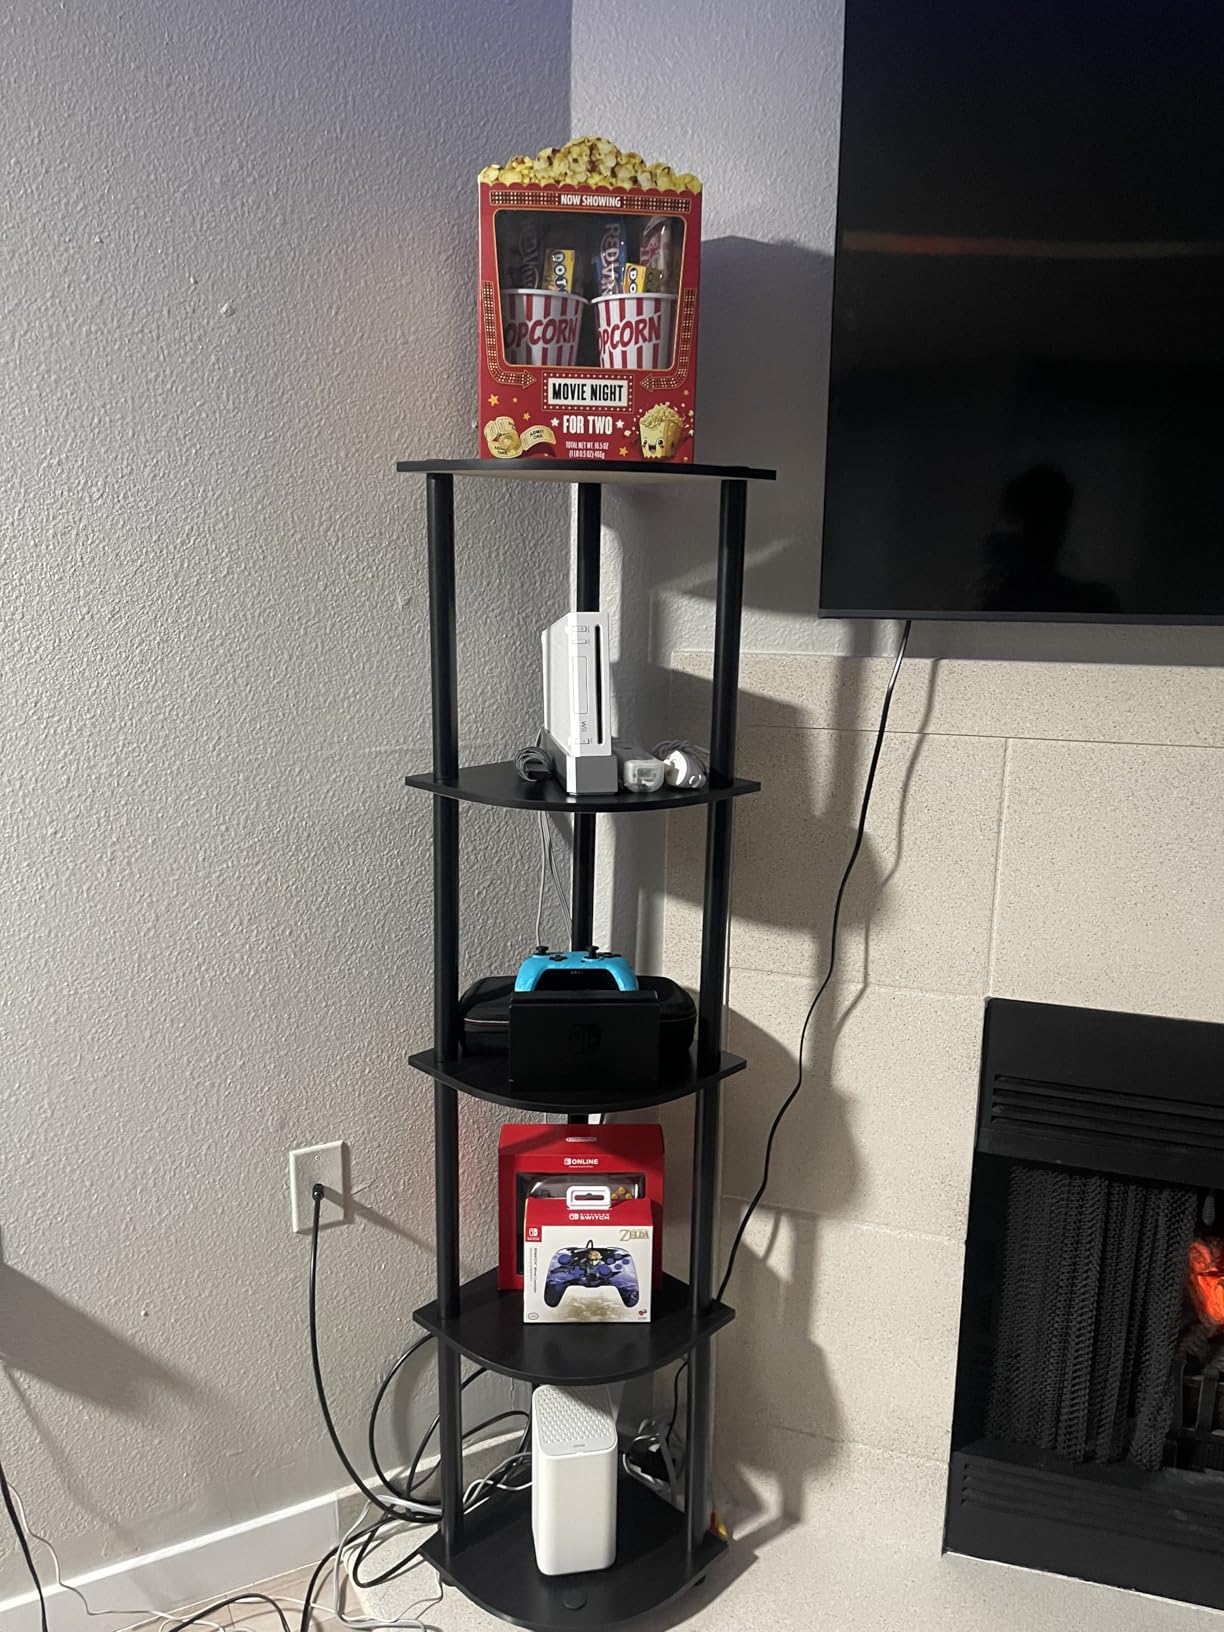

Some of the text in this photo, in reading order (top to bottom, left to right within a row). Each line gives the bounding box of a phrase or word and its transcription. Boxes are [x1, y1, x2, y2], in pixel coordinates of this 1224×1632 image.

[560, 194, 621, 207] NOW SHOWING
[551, 253, 568, 292] DOT
[552, 382, 624, 402] MOVIE NIGHT
[563, 415, 612, 435] FOR TWO
[565, 440, 577, 449] TOTAL
[578, 441, 586, 449] NET
[619, 1229, 649, 1242] ZELDA
